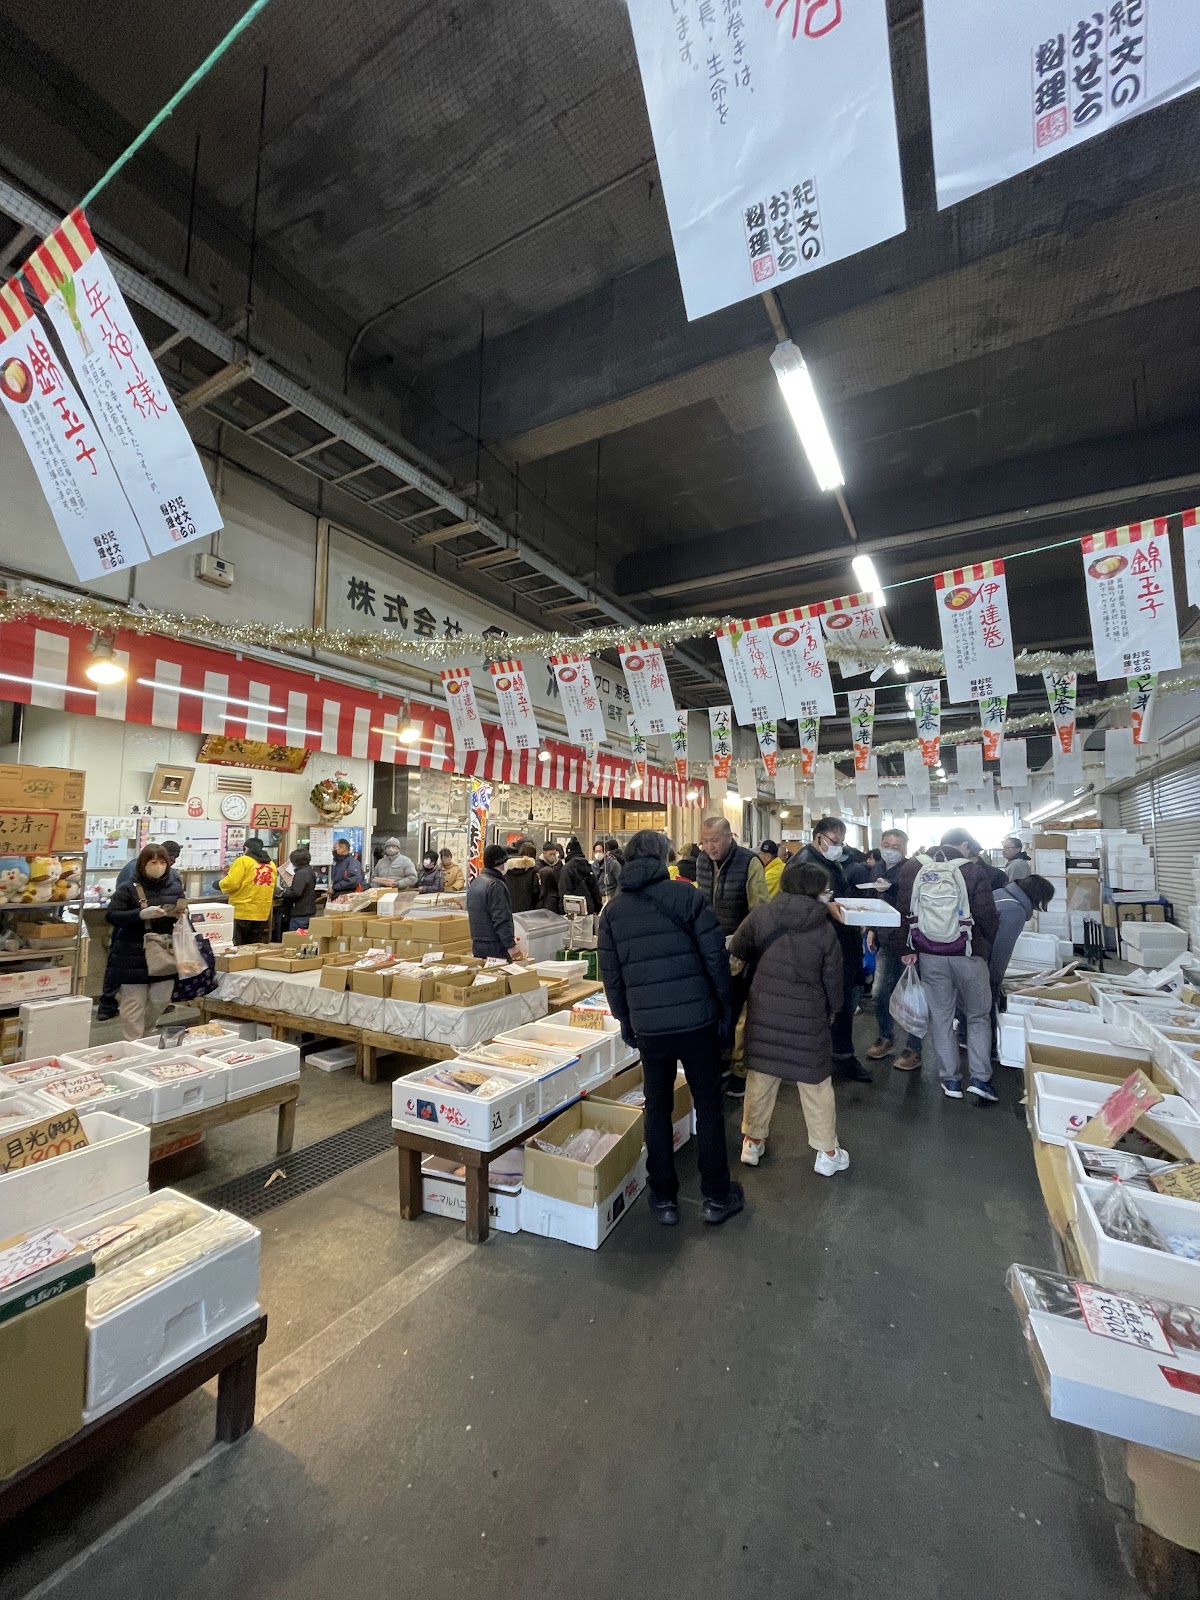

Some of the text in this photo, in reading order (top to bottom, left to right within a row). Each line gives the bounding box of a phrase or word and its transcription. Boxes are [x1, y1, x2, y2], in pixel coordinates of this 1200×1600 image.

[698, 0, 729, 124] 長・生命を
[1072, 12, 1103, 128] おせち
[1109, 0, 1144, 108] 紀文の
[769, 191, 797, 271] おせち
[792, 179, 821, 260] 紀文の
[81, 279, 167, 419] 年神様
[26, 328, 98, 475] 錦玉子
[1131, 541, 1164, 619] 錦玉子
[976, 582, 1004, 649] 伊達巻
[644, 652, 665, 691] 蒲鉾
[745, 633, 773, 680] 年神様
[800, 621, 825, 678] なると巻
[577, 663, 597, 710] なると巻
[853, 693, 873, 745] なると巻
[1045, 674, 1075, 715] 達巻
[713, 710, 731, 756] なると巻
[254, 806, 289, 828] 会計
